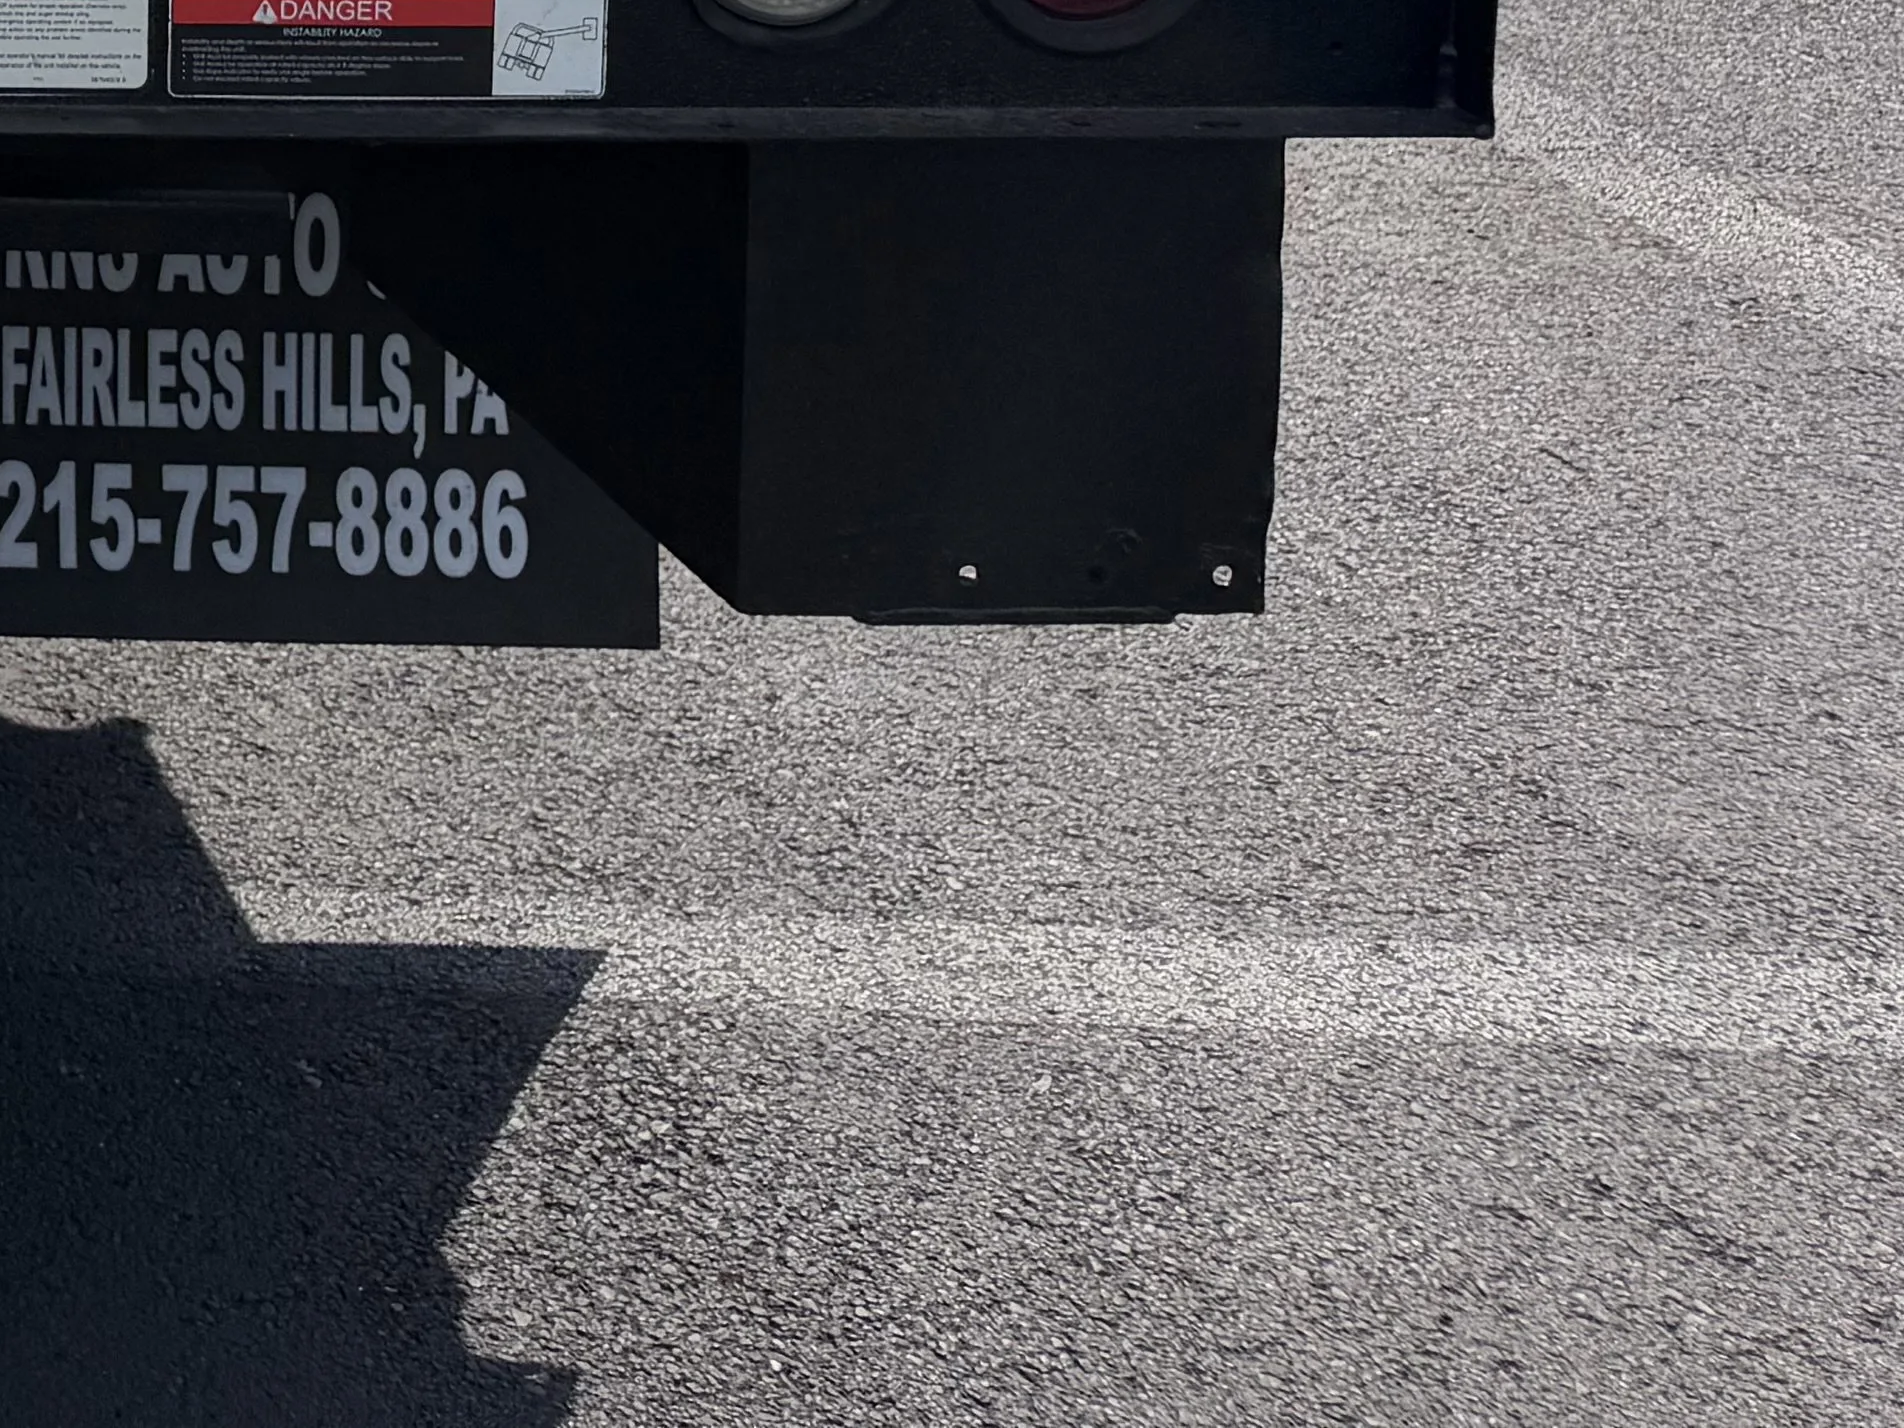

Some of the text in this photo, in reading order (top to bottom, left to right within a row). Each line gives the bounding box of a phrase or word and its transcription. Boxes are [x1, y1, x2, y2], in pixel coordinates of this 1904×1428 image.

[280, 0, 393, 21] DANGER
[283, 27, 383, 38] INSTABILITY HAZARD
[3, 326, 245, 431] FAIRLESS
[263, 331, 427, 460] HILLS,
